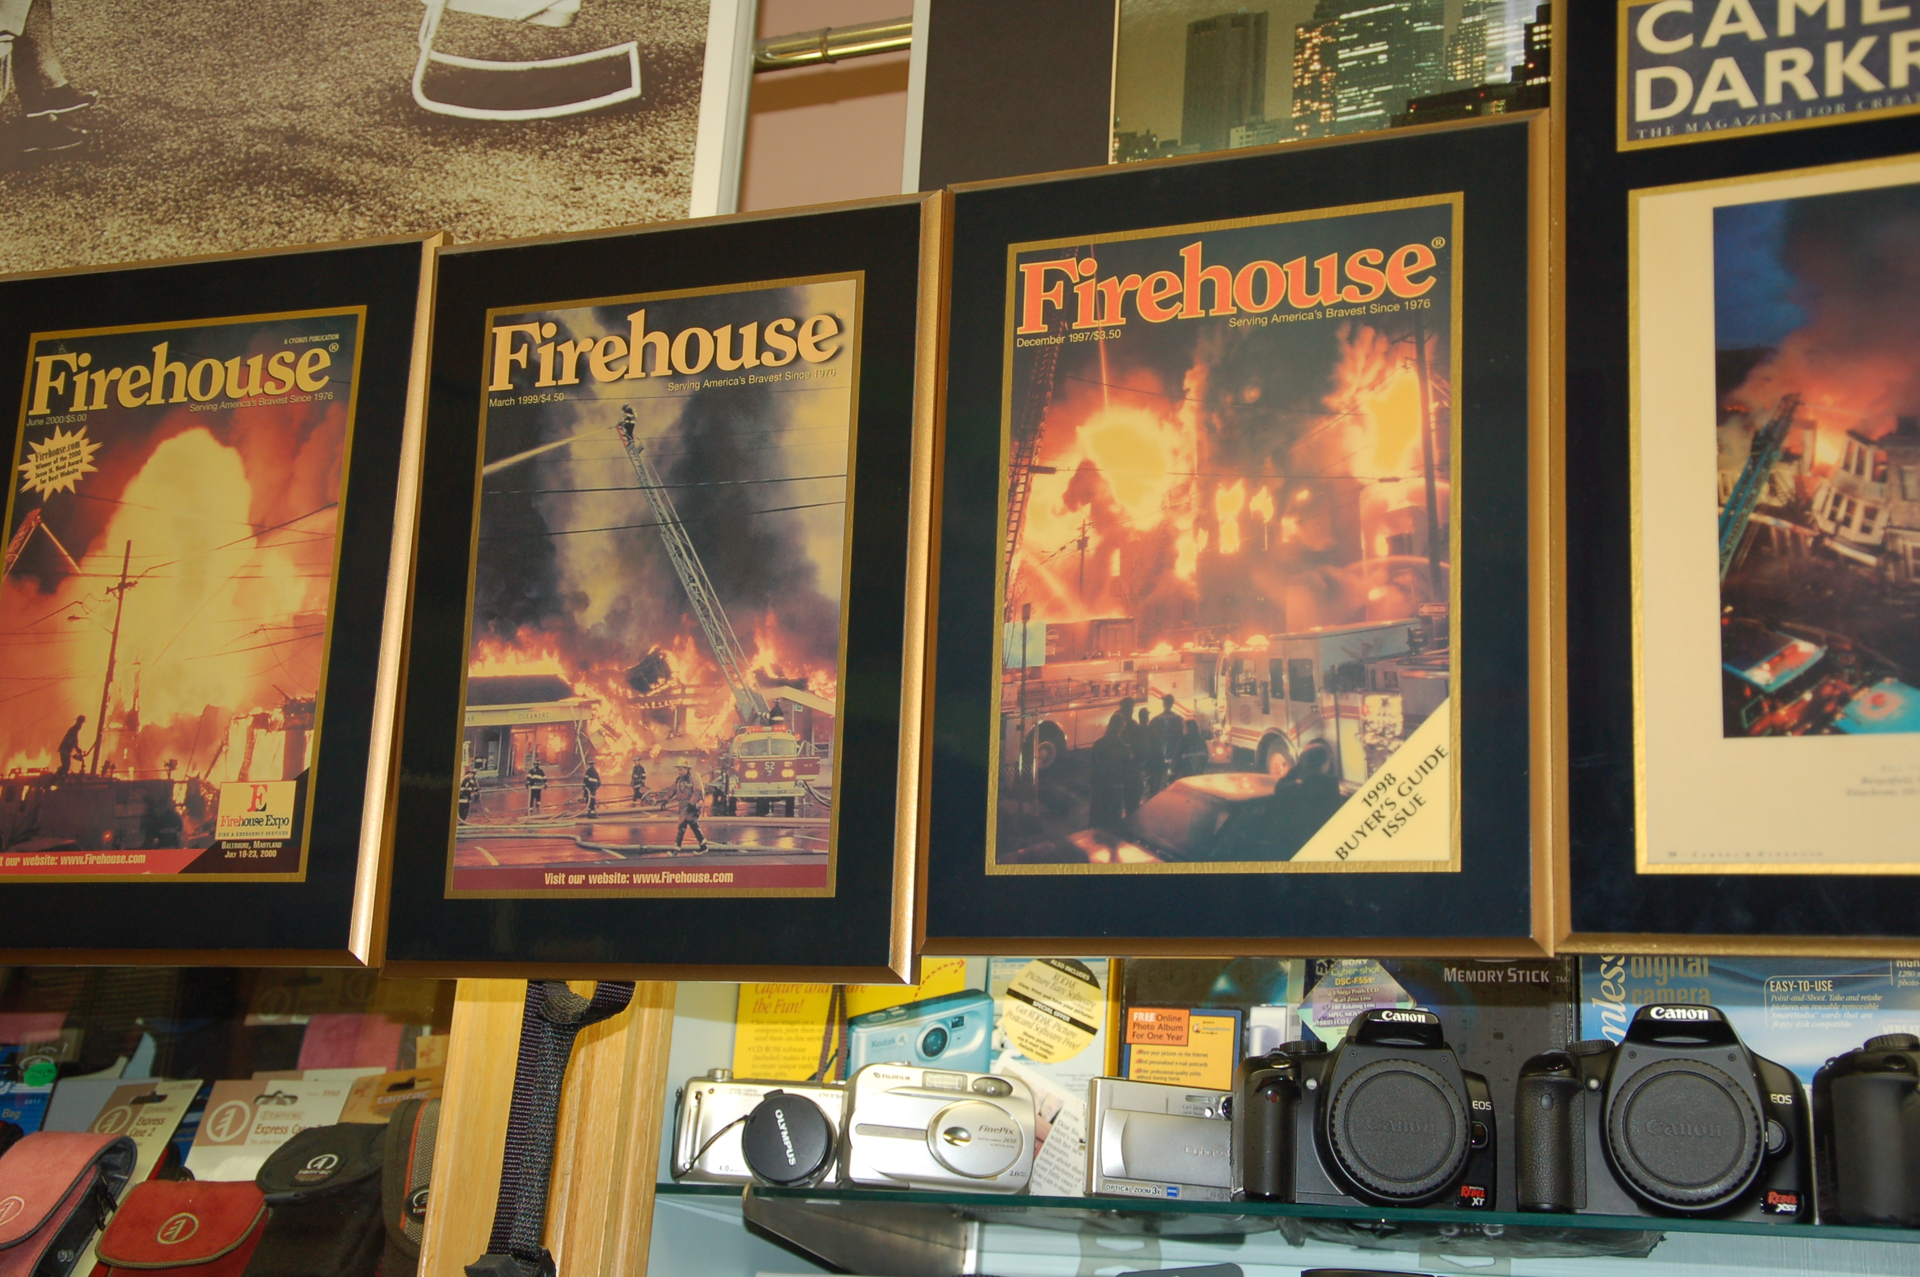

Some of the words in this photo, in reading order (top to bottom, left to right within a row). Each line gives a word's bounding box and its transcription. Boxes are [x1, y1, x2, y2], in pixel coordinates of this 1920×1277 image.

[1637, 124, 1676, 140] THE
[1685, 109, 1796, 134] MAGAZINE
[1805, 102, 1846, 118] FOR
[1229, 317, 1268, 328] Serving
[1271, 310, 1323, 323] America's
[1325, 307, 1367, 319] Bravest
[1369, 303, 1400, 314] Since
[1404, 299, 1431, 310] 1976
[309, 333, 340, 343] PUBLICATION
[1017, 335, 1066, 348] December
[1068, 329, 1122, 343] 1997/$3.50
[667, 381, 700, 392] Serving
[703, 376, 746, 388] America's
[748, 372, 782, 384] Bravest
[785, 369, 811, 381] Since
[814, 368, 837, 378] 1976
[189, 403, 218, 413] Serving
[219, 399, 257, 410] America's
[259, 396, 288, 406] Bravest
[290, 394, 312, 403] Since
[314, 391, 333, 401] 1976
[489, 396, 515, 408] March
[518, 392, 565, 406] 1999/$4.50
[26, 418, 44, 426] June
[46, 413, 87, 425] 2000/$5.00
[35, 441, 81, 462] Firehouse.com
[35, 462, 52, 470] Winner
[69, 450, 82, 459] 2000
[67, 457, 83, 465] Award
[48, 474, 59, 482] Best
[60, 468, 79, 477] Website
[518, 712, 549, 720] CLEANERS
[765, 761, 775, 770] 52
[1361, 772, 1397, 808] 1998
[1334, 796, 1397, 861] BUYER'S
[1397, 744, 1449, 798] GUIDE
[220, 815, 263, 827] Firehouse
[264, 814, 290, 829] Expo
[1381, 792, 1427, 839] ISSUE
[5, 856, 20, 866] our
[23, 854, 58, 866] website:
[60, 853, 146, 865] www.Firehouse.com
[260, 849, 277, 857] 2000
[545, 872, 566, 885] Visit
[568, 874, 586, 885] our
[588, 871, 630, 884] website:
[632, 871, 734, 884] www.Firehouse.com
[1050, 959, 1065, 969] ALSO
[1064, 965, 1090, 981] INCLUDES
[1444, 967, 1504, 983] MEMORY
[1508, 967, 1550, 983] STICK
[1630, 956, 1709, 986] digital
[1052, 972, 1077, 989] KODAK
[1770, 980, 1833, 992] EASY-TO-USE
[1025, 971, 1051, 988] Picture
[1049, 982, 1068, 995] Easy
[1067, 988, 1096, 1008] Software
[1632, 987, 1711, 1006] camera
[1771, 994, 1827, 1002] Point-and-Shoot.
[1860, 994, 1883, 1002] retake
[753, 998, 772, 1014] the
[774, 998, 805, 1014] Fun!
[1032, 1000, 1054, 1015] SPECIAL
[1053, 1010, 1071, 1022] OFFER
[1650, 1006, 1708, 1020] Canon
[1771, 1003, 1799, 1011] pictures
[1015, 1004, 1028, 1015] Get
[1028, 1010, 1052, 1027] KODAK
[1052, 1021, 1077, 1039] Picture
[1133, 1012, 1155, 1022] FREE
[1156, 1014, 1182, 1022] Online
[1381, 1010, 1426, 1023] Canon
[1005, 1010, 1036, 1031] Postcard
[1034, 1023, 1063, 1043] Software
[1062, 1034, 1080, 1051] Free!
[1132, 1022, 1155, 1031] Photo
[1158, 1023, 1183, 1032] Album
[1771, 1021, 1794, 1030] floppy
[1811, 1021, 1853, 1029] compatible.
[871, 1038, 896, 1048] Kodak
[1132, 1032, 1144, 1040] For
[1147, 1032, 1163, 1040] One
[1166, 1033, 1183, 1041] Year
[377, 1090, 432, 1104] tamrac
[1770, 1093, 1793, 1105] EOS
[1472, 1100, 1492, 1111] EOS
[2, 1108, 21, 1120] Bag
[136, 1117, 166, 1126] Express
[1057, 1120, 1070, 1131] Dear
[1365, 1118, 1436, 1136] Canon
[1645, 1118, 1723, 1138] Canon
[129, 1128, 147, 1137] Case
[148, 1127, 156, 1137] 2
[255, 1124, 288, 1135] Express
[978, 1125, 1014, 1135] FinePix
[774, 1109, 796, 1166] OLYMPUS
[1050, 1133, 1062, 1144] with
[1062, 1140, 1071, 1149] her
[1072, 1147, 1082, 1157] new
[1043, 1147, 1055, 1159] How
[1056, 1155, 1071, 1167] about
[1106, 1184, 1133, 1192] OPTICAL
[1134, 1186, 1151, 1194] ZOOM
[1152, 1186, 1161, 1195] 3x
[1471, 1197, 1485, 1207] XT
